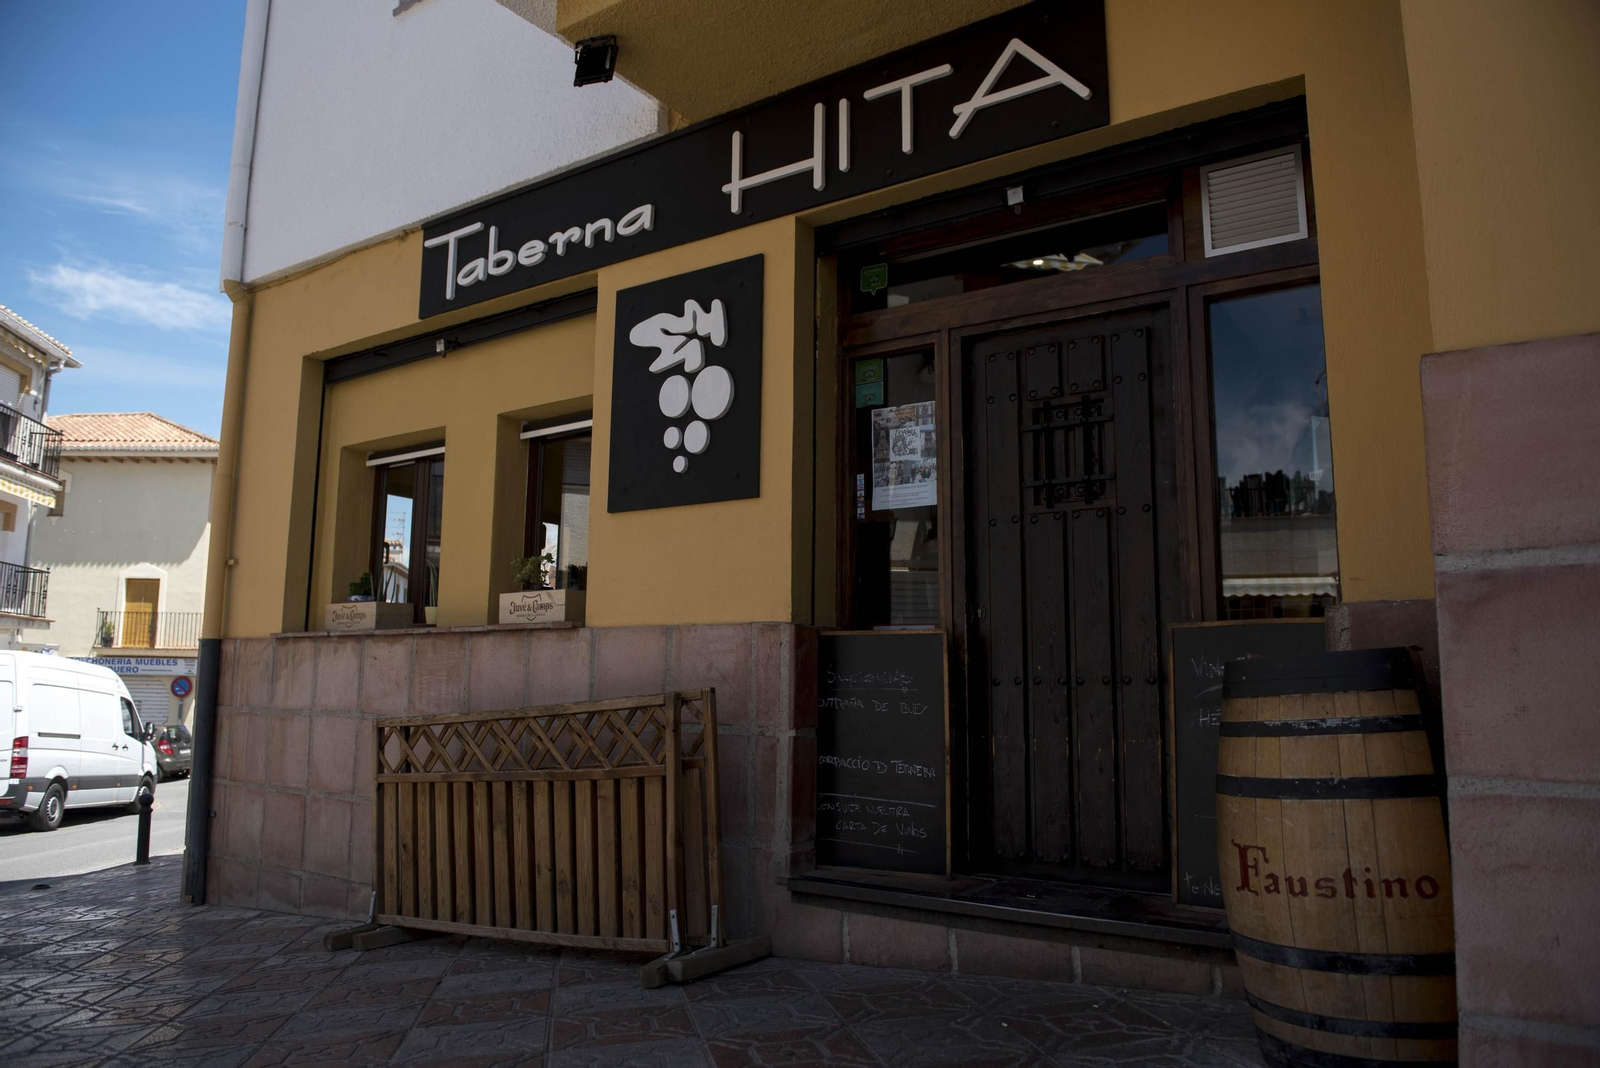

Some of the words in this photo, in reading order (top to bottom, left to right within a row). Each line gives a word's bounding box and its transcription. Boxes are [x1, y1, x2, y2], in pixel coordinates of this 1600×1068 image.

[424, 203, 656, 301] Taberna
[721, 38, 1092, 214] HITA
[532, 600, 554, 613] Camps
[135, 658, 178, 666] MUEBLES
[872, 700, 889, 712] DE
[900, 702, 928, 716] BUEY
[890, 760, 936, 778] TERNERA
[836, 820, 867, 832] CARTA
[1231, 838, 1440, 900] Faustino
